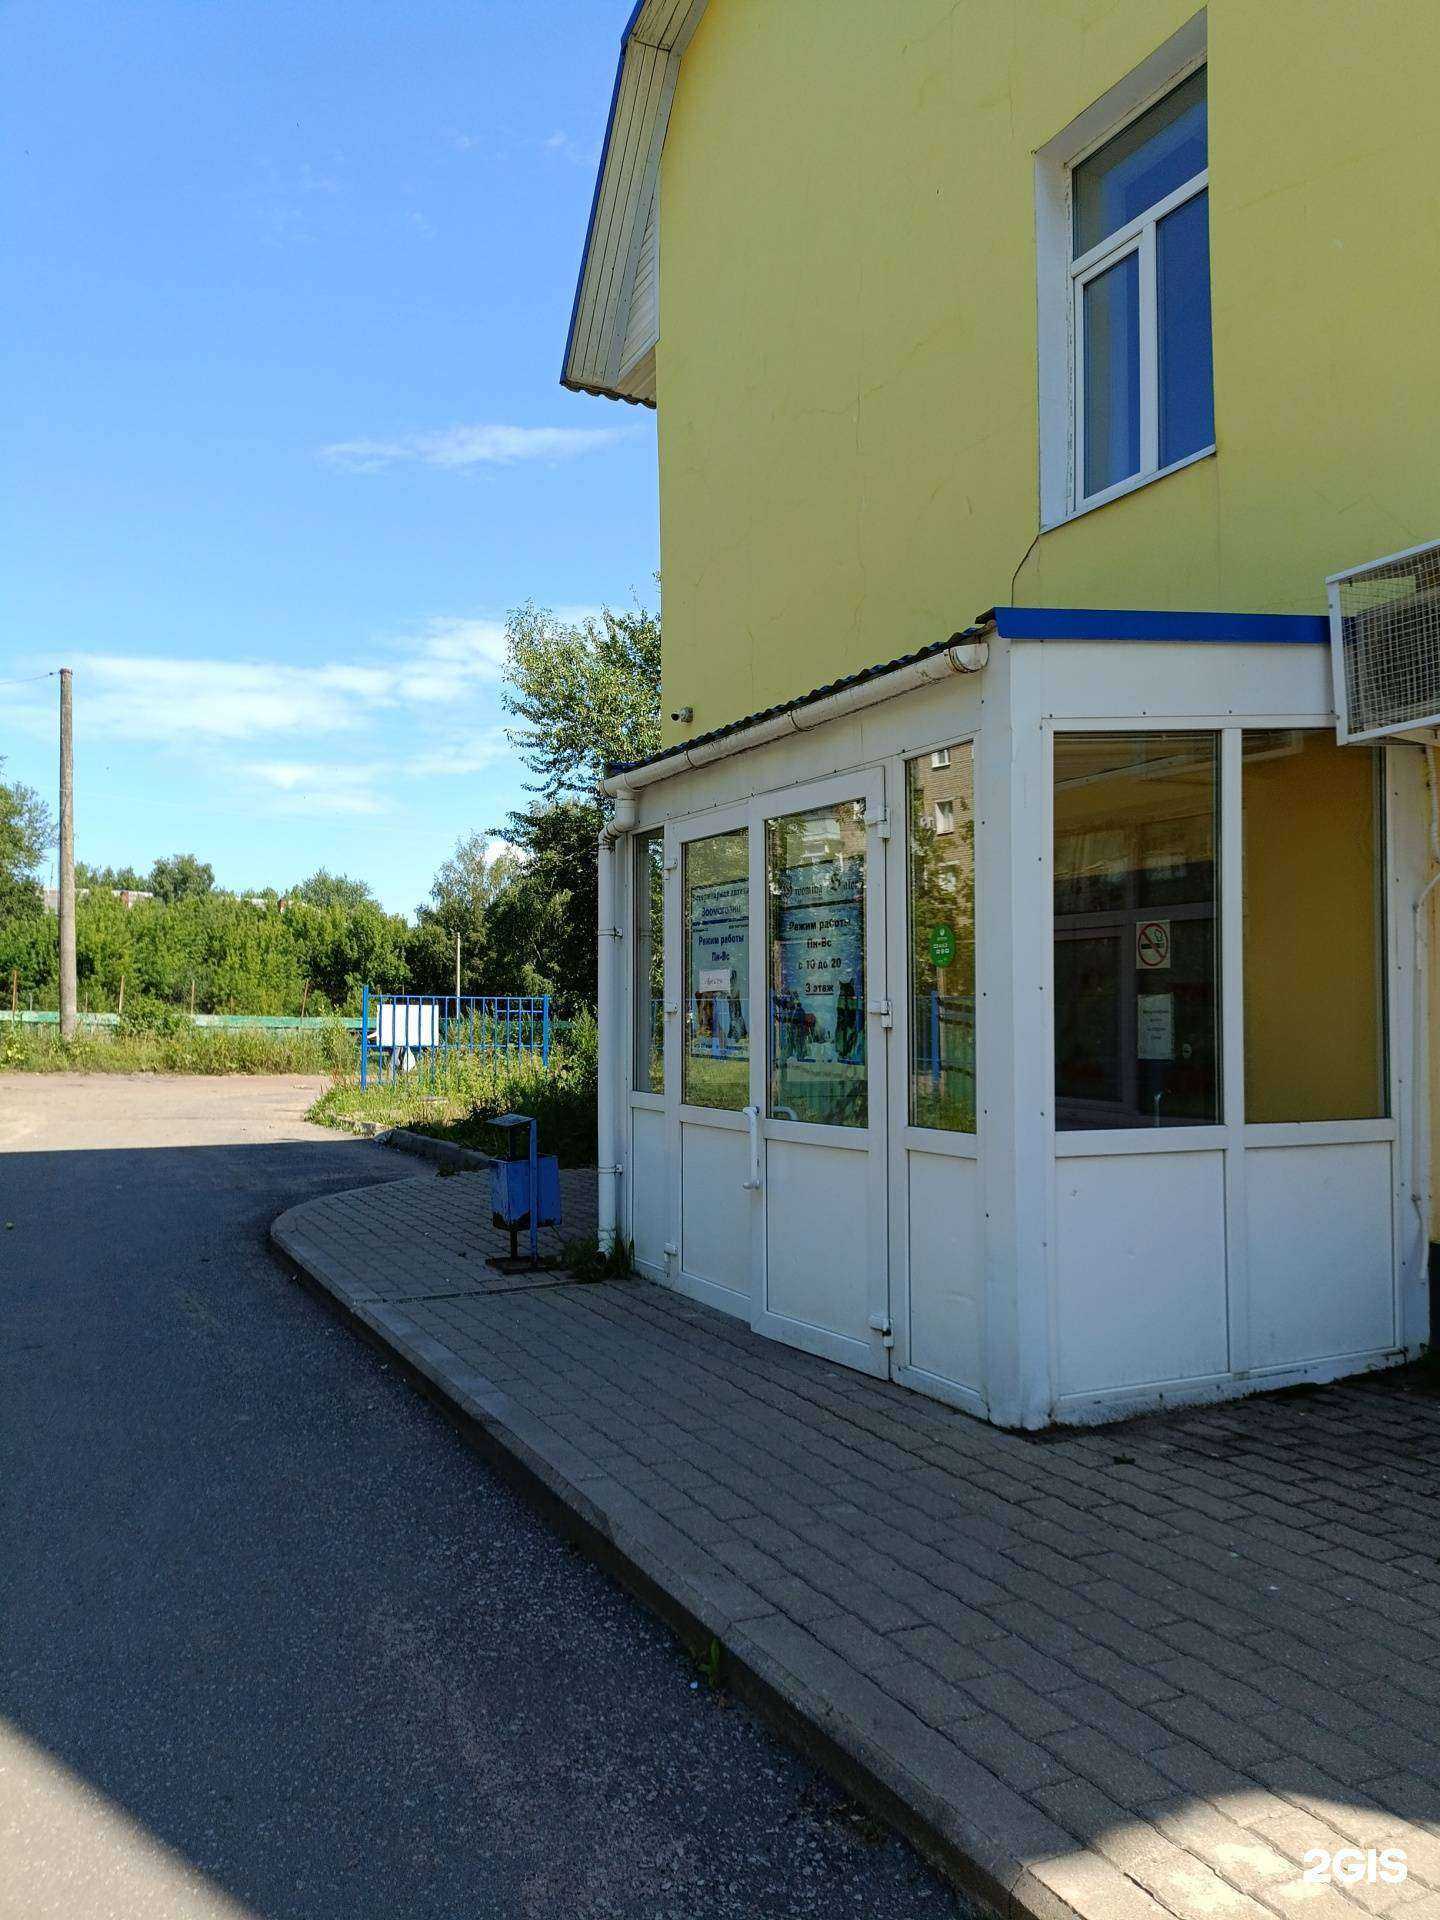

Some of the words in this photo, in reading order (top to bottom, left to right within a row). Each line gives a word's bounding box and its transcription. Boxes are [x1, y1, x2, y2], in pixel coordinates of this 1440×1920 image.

[789, 921, 816, 932] Режим
[820, 919, 849, 932] работы
[699, 936, 719, 946] Режим
[720, 934, 745, 947] работы
[807, 937, 832, 949] Пн-Вс
[712, 951, 730, 962] Пн-Вс
[806, 959, 816, 970] 10
[818, 961, 828, 970] до
[831, 958, 841, 968] 20
[805, 983, 811, 993] 3
[813, 984, 834, 992] этаж
